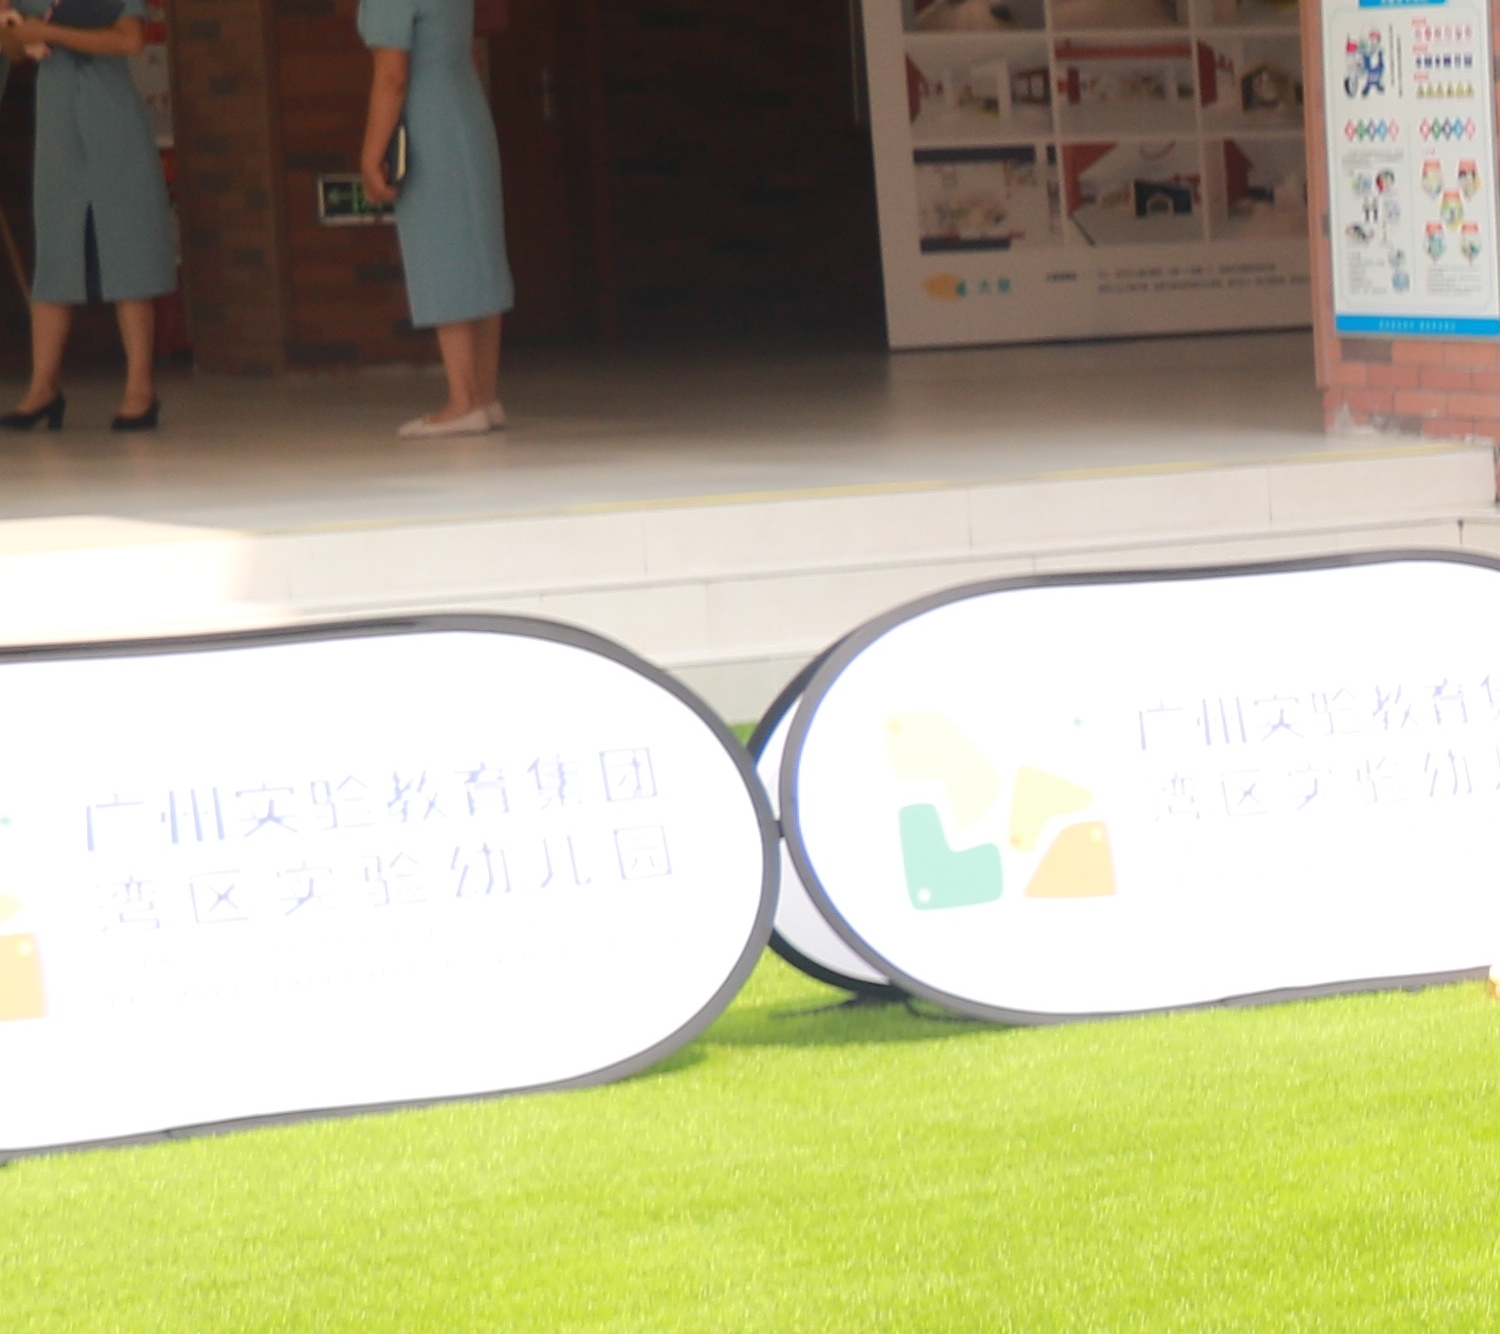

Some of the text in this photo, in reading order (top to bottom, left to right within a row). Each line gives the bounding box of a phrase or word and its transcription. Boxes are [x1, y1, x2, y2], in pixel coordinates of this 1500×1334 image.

[85, 746, 659, 852] 广州实验教育集团
[97, 824, 673, 933] 湾区实验幼儿园
